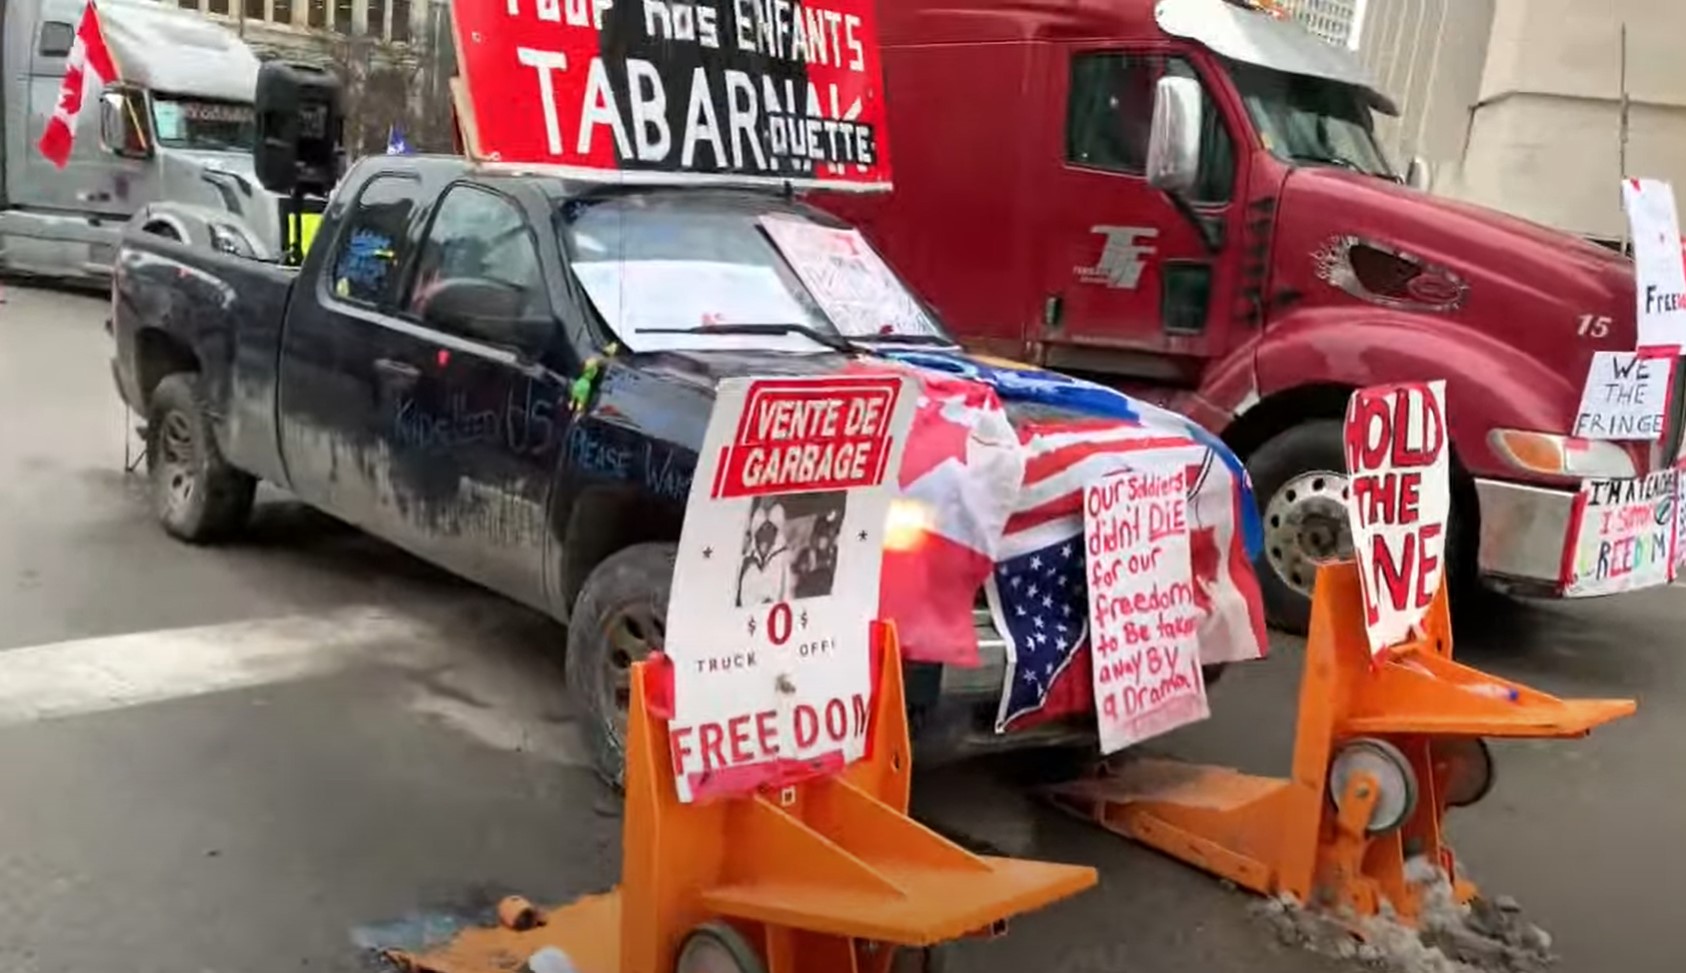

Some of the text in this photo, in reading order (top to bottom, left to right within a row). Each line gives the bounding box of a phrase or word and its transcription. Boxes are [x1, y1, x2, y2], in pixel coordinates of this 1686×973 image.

[735, 0, 864, 71] ENFANTS
[1577, 314, 1612, 338] 15
[1612, 355, 1650, 381] WE
[1604, 383, 1648, 404] THE
[757, 397, 884, 441] VENTE DE
[1346, 387, 1444, 473] HOLD
[1575, 413, 1665, 437] FRINGE
[742, 442, 873, 488] GARBAGE
[1088, 479, 1124, 517] Our
[1353, 472, 1421, 528] THE
[1092, 547, 1162, 588] for our
[1356, 523, 1442, 627] LNE
[1095, 582, 1193, 628] freedom
[697, 651, 757, 673] TRUCK
[1097, 634, 1119, 658] to
